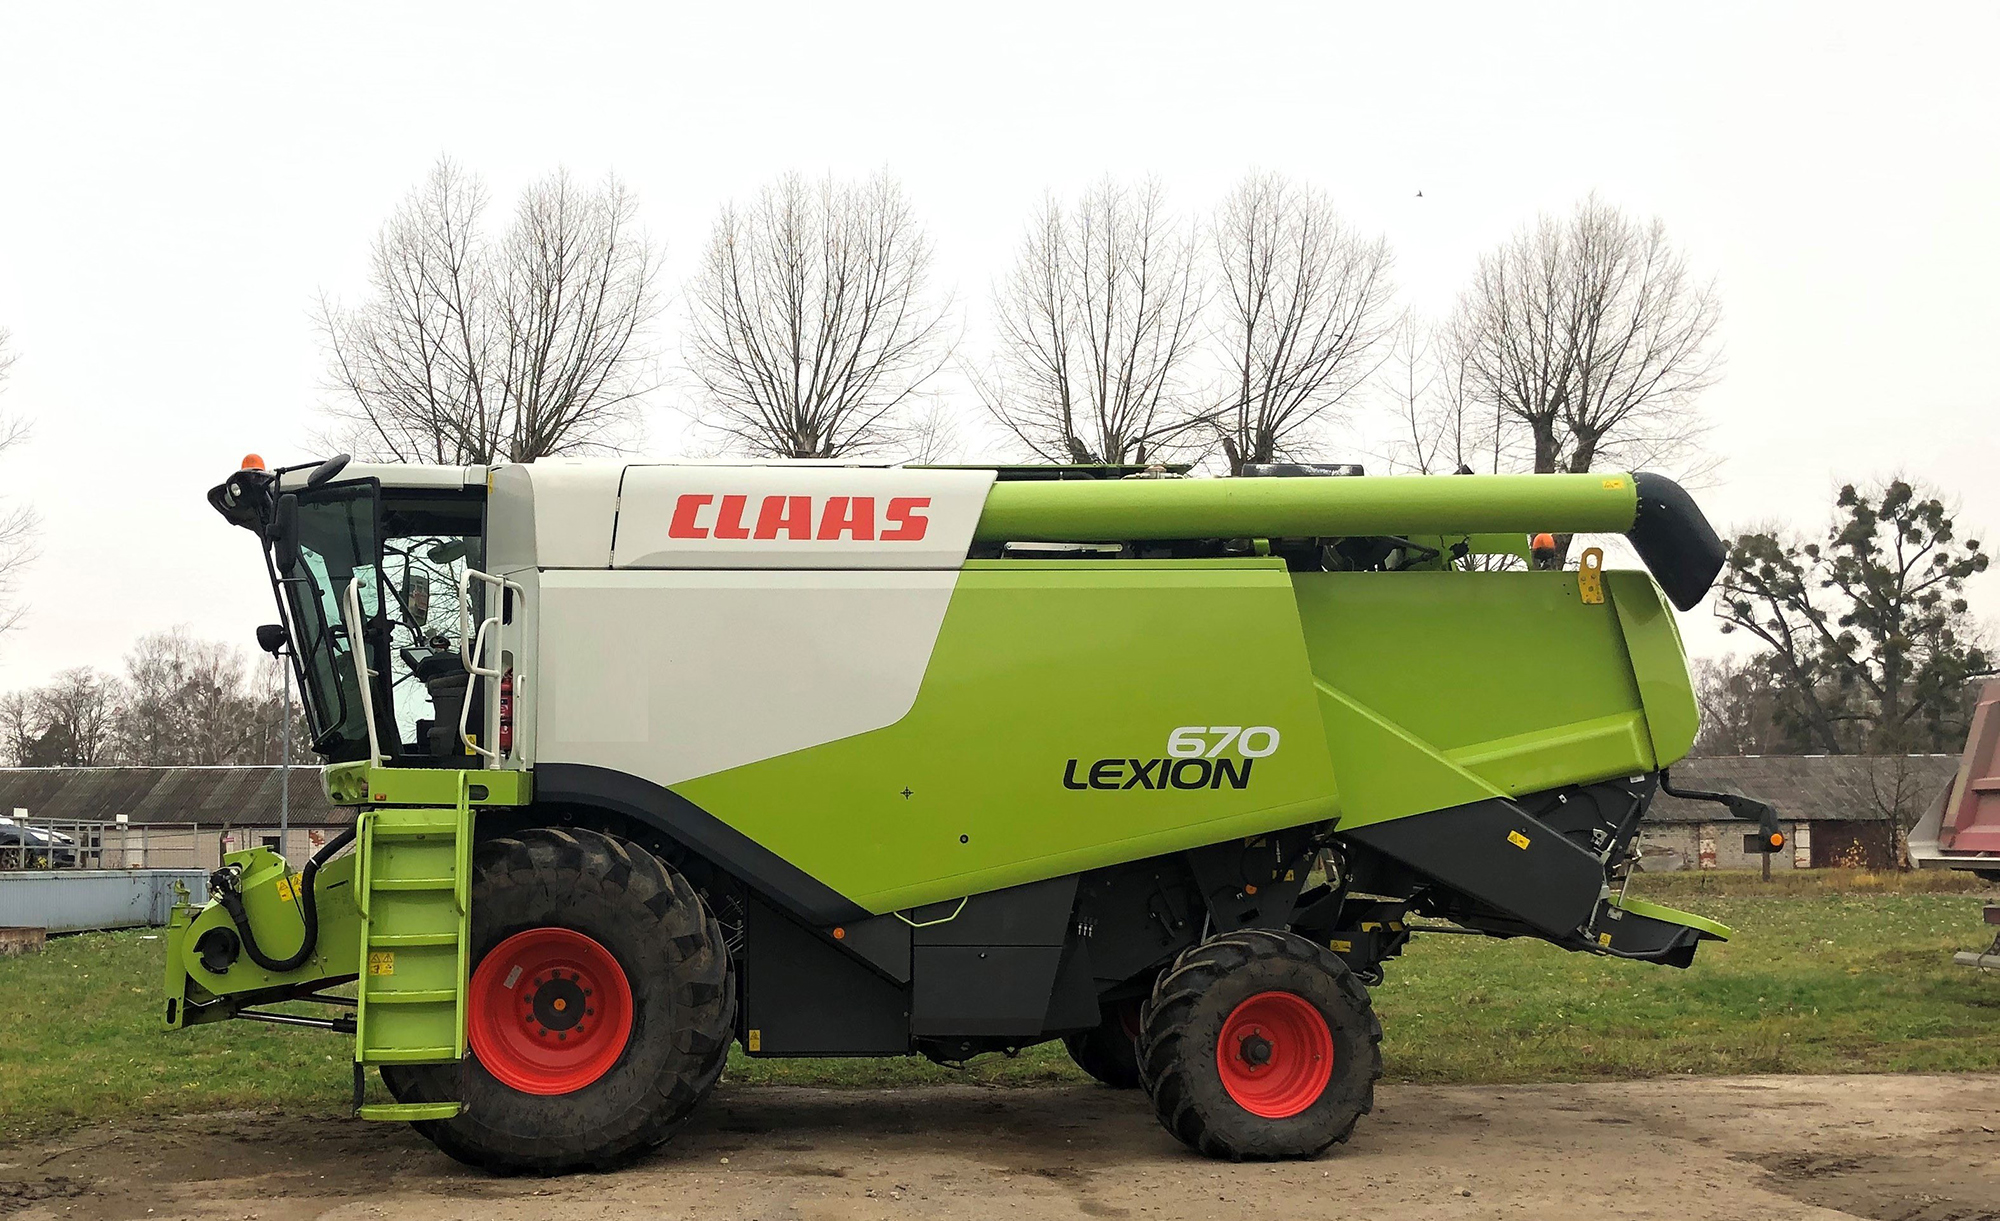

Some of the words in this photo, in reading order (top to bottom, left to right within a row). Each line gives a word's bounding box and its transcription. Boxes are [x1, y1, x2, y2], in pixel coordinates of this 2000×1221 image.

[668, 494, 931, 541] CLAAS
[1167, 726, 1280, 758] 670
[1063, 758, 1254, 790] LEXION
